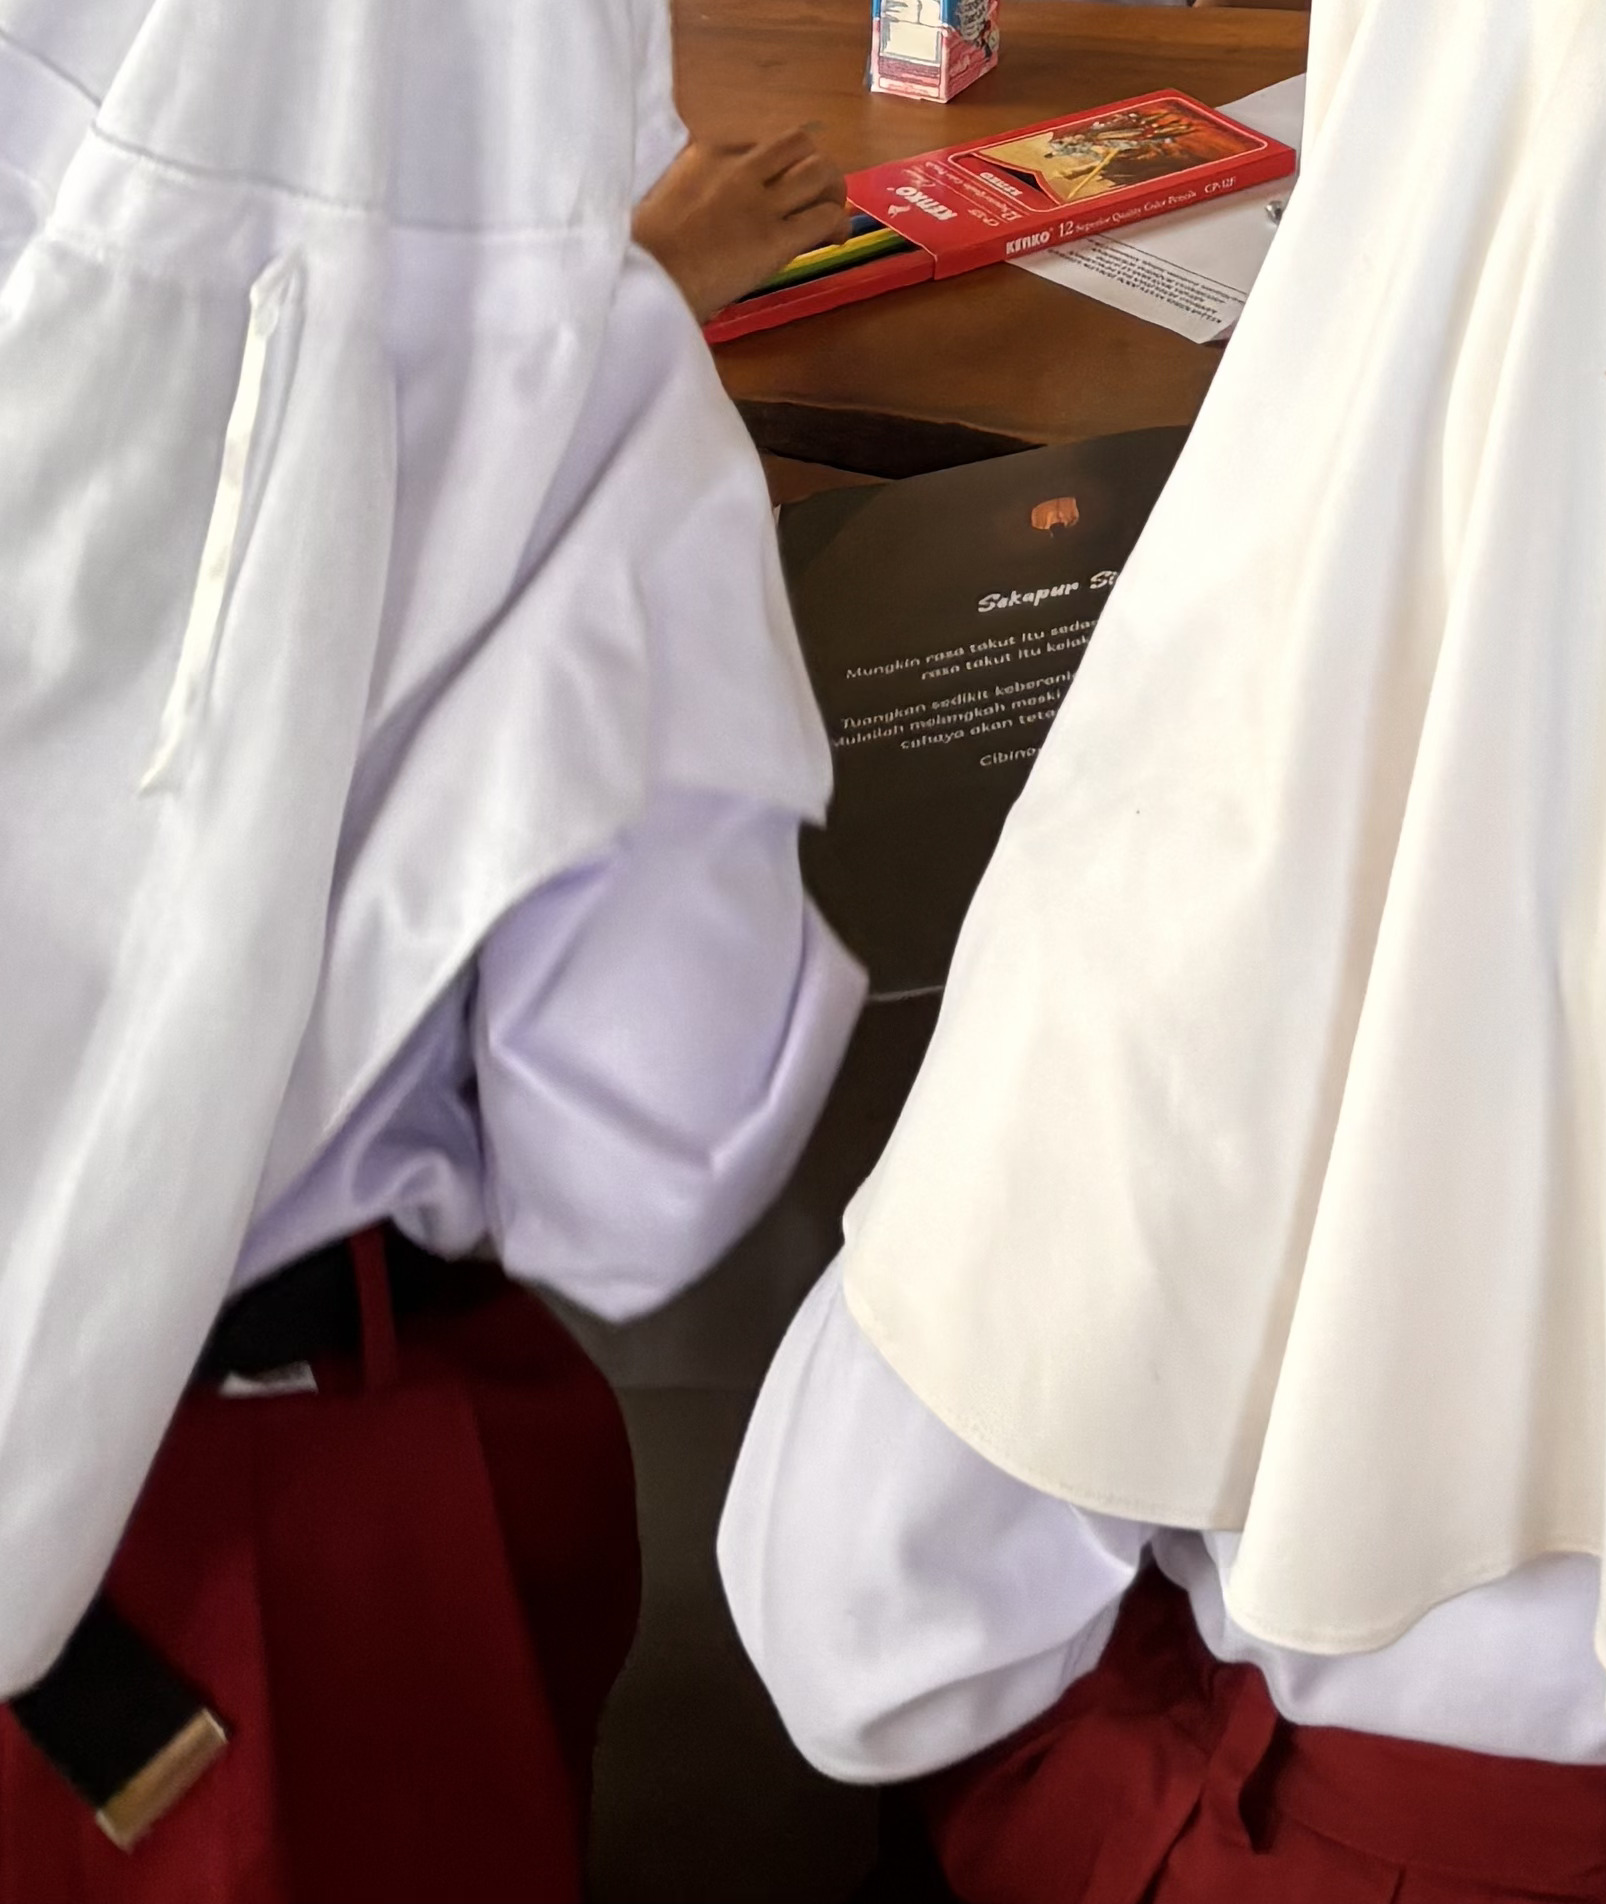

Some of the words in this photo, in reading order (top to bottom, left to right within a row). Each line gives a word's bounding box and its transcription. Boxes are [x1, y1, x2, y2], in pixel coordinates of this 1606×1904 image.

[1059, 222, 1075, 236] 12
[1112, 209, 1141, 222] Quality
[978, 582, 1080, 613] Sekapur
[1089, 570, 1118, 589] Si
[845, 656, 921, 679] Mungkin
[925, 646, 965, 663] rasa
[969, 634, 1016, 653] takut
[965, 653, 1012, 671] takut
[842, 702, 927, 728] Tuangkan
[930, 689, 988, 711] sedikit
[994, 670, 1074, 696] keberani
[909, 702, 1006, 731] melangkah
[969, 717, 1014, 736] akan
[1018, 708, 1057, 724] teta
